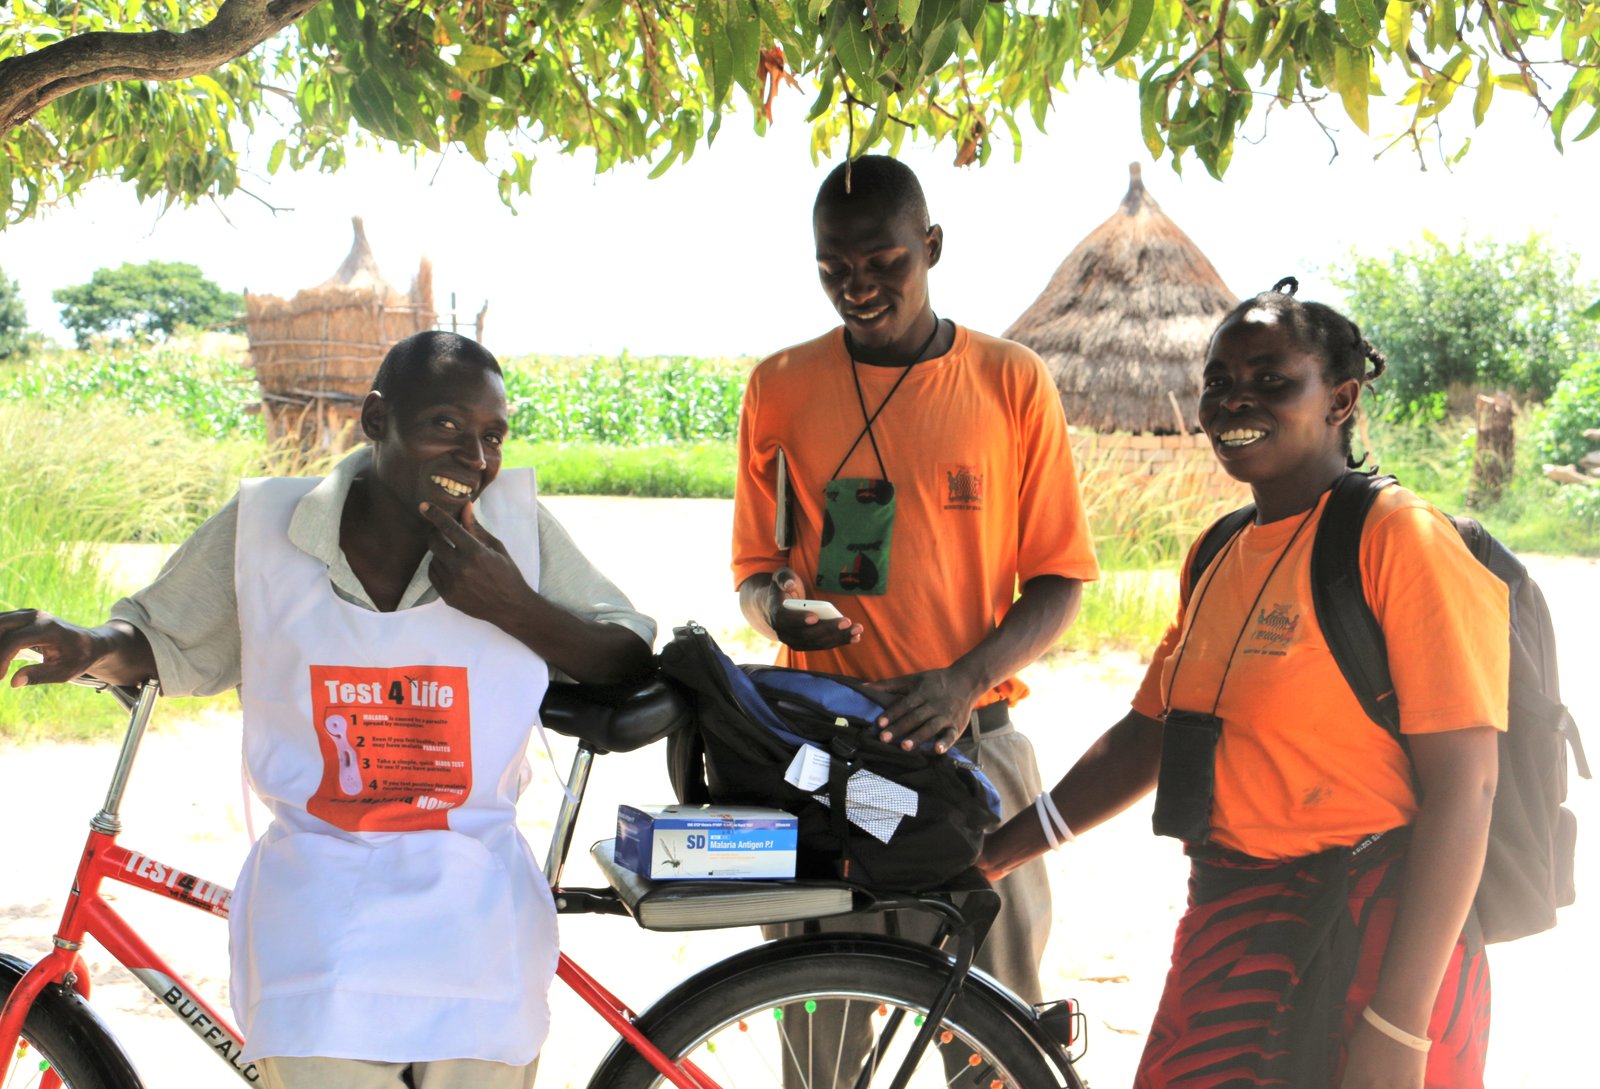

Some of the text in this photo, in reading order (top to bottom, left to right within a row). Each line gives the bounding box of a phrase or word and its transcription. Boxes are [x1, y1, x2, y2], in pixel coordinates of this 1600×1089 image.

[324, 680, 454, 708] Test 4 Life
[350, 714, 357, 726] 1
[356, 736, 365, 747] 2
[362, 758, 370, 769] 3
[369, 780, 378, 790] 4
[686, 835, 706, 849] SD
[710, 840, 736, 849] Malaria
[738, 840, 764, 850] Antigen
